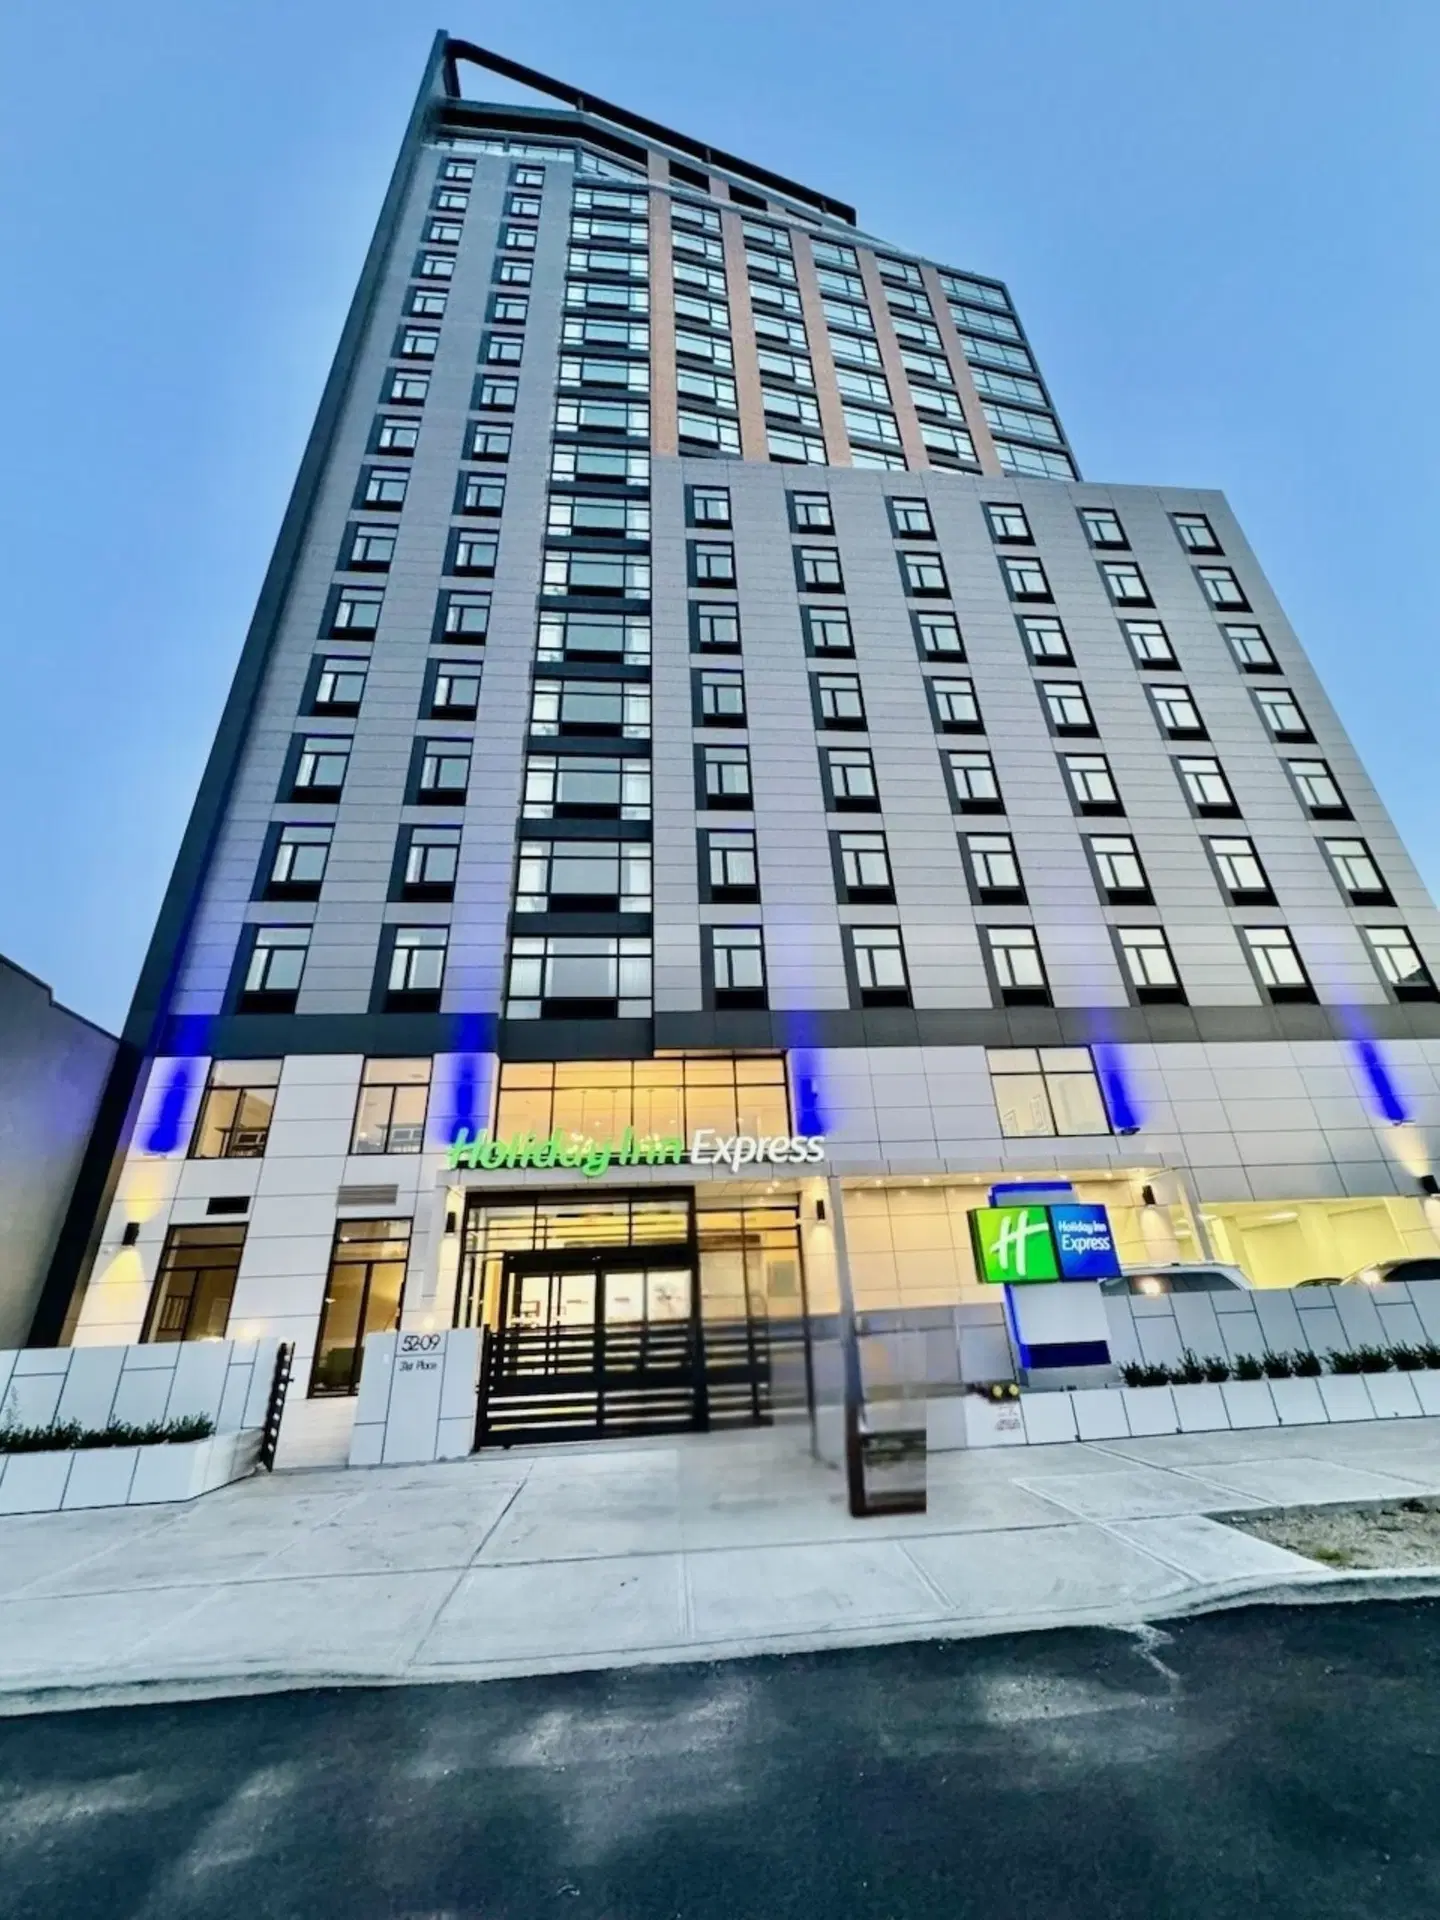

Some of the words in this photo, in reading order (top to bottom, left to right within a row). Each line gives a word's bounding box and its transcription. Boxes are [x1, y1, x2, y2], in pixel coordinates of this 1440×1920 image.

[448, 1127, 613, 1176] Holiday
[618, 1126, 682, 1165] Inn
[689, 1128, 825, 1173] Express
[1058, 1220, 1093, 1235] Holiday
[1092, 1220, 1107, 1232] Inn
[1062, 1234, 1111, 1254] Express
